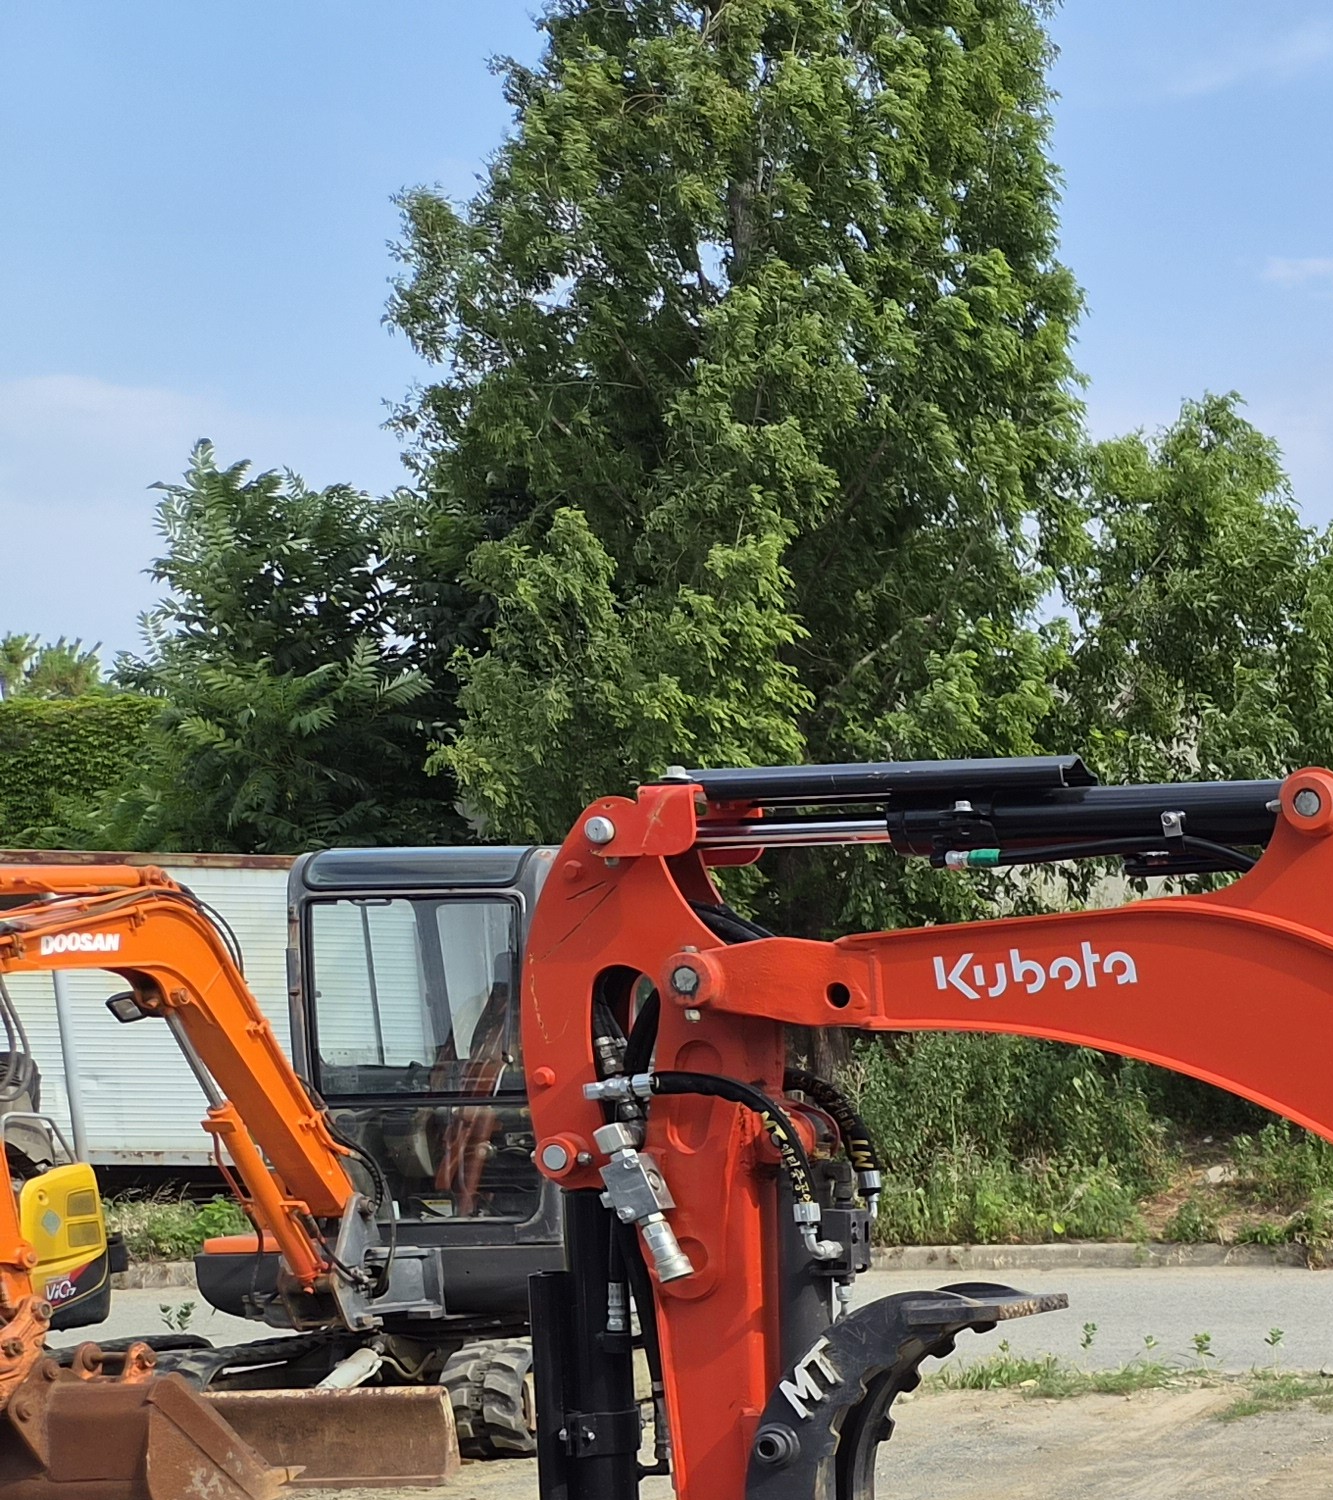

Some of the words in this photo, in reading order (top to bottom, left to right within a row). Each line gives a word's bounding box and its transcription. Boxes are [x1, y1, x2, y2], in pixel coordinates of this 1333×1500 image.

[41, 932, 120, 956] DOOSAN
[933, 941, 1138, 999] Kubota
[779, 1334, 844, 1419] MT
